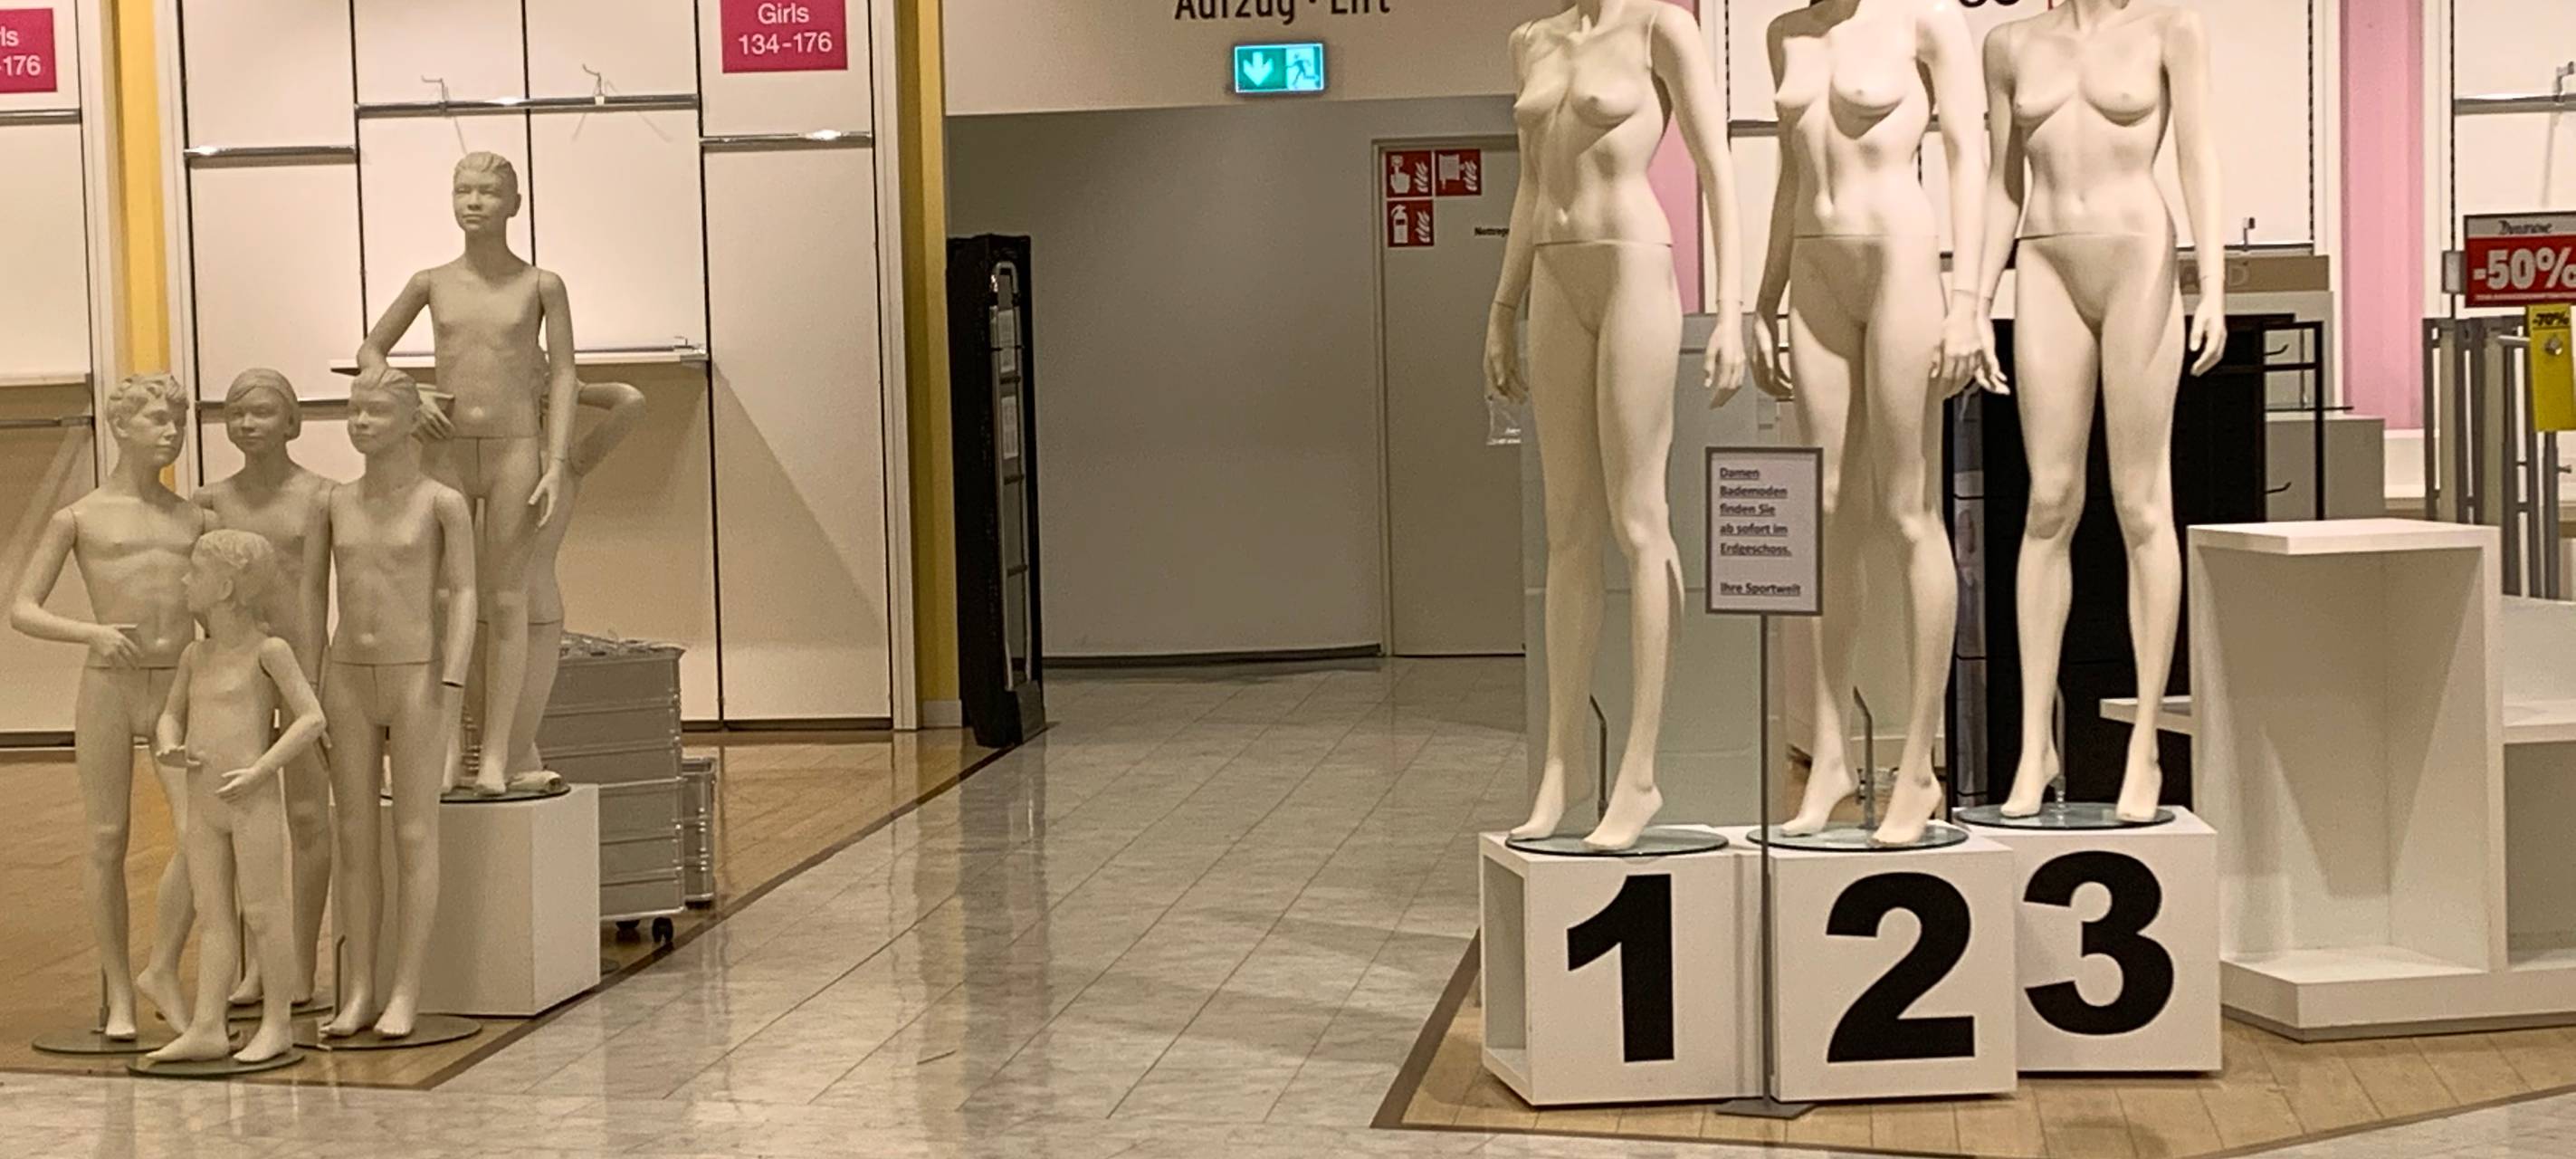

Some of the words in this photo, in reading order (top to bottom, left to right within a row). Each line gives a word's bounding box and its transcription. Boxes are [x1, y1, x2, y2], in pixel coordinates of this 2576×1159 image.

[758, 2, 810, 24] Girls
[738, 31, 833, 55] 134-176
[2473, 246, 2576, 290] -50%
[1720, 467, 1760, 480] Damen
[1720, 485, 1788, 499] Bademoden
[1720, 503, 1756, 516] finden
[1759, 503, 1776, 516] Sie
[1721, 522, 1734, 536] ab
[1736, 522, 1770, 536] sofort
[1773, 523, 1788, 536] im
[1721, 582, 1742, 595] Ihre
[1745, 582, 1801, 597] Sportwelt
[2023, 850, 2174, 1036] 3
[1566, 873, 1675, 1064] 1
[1826, 871, 1975, 1064] 2
